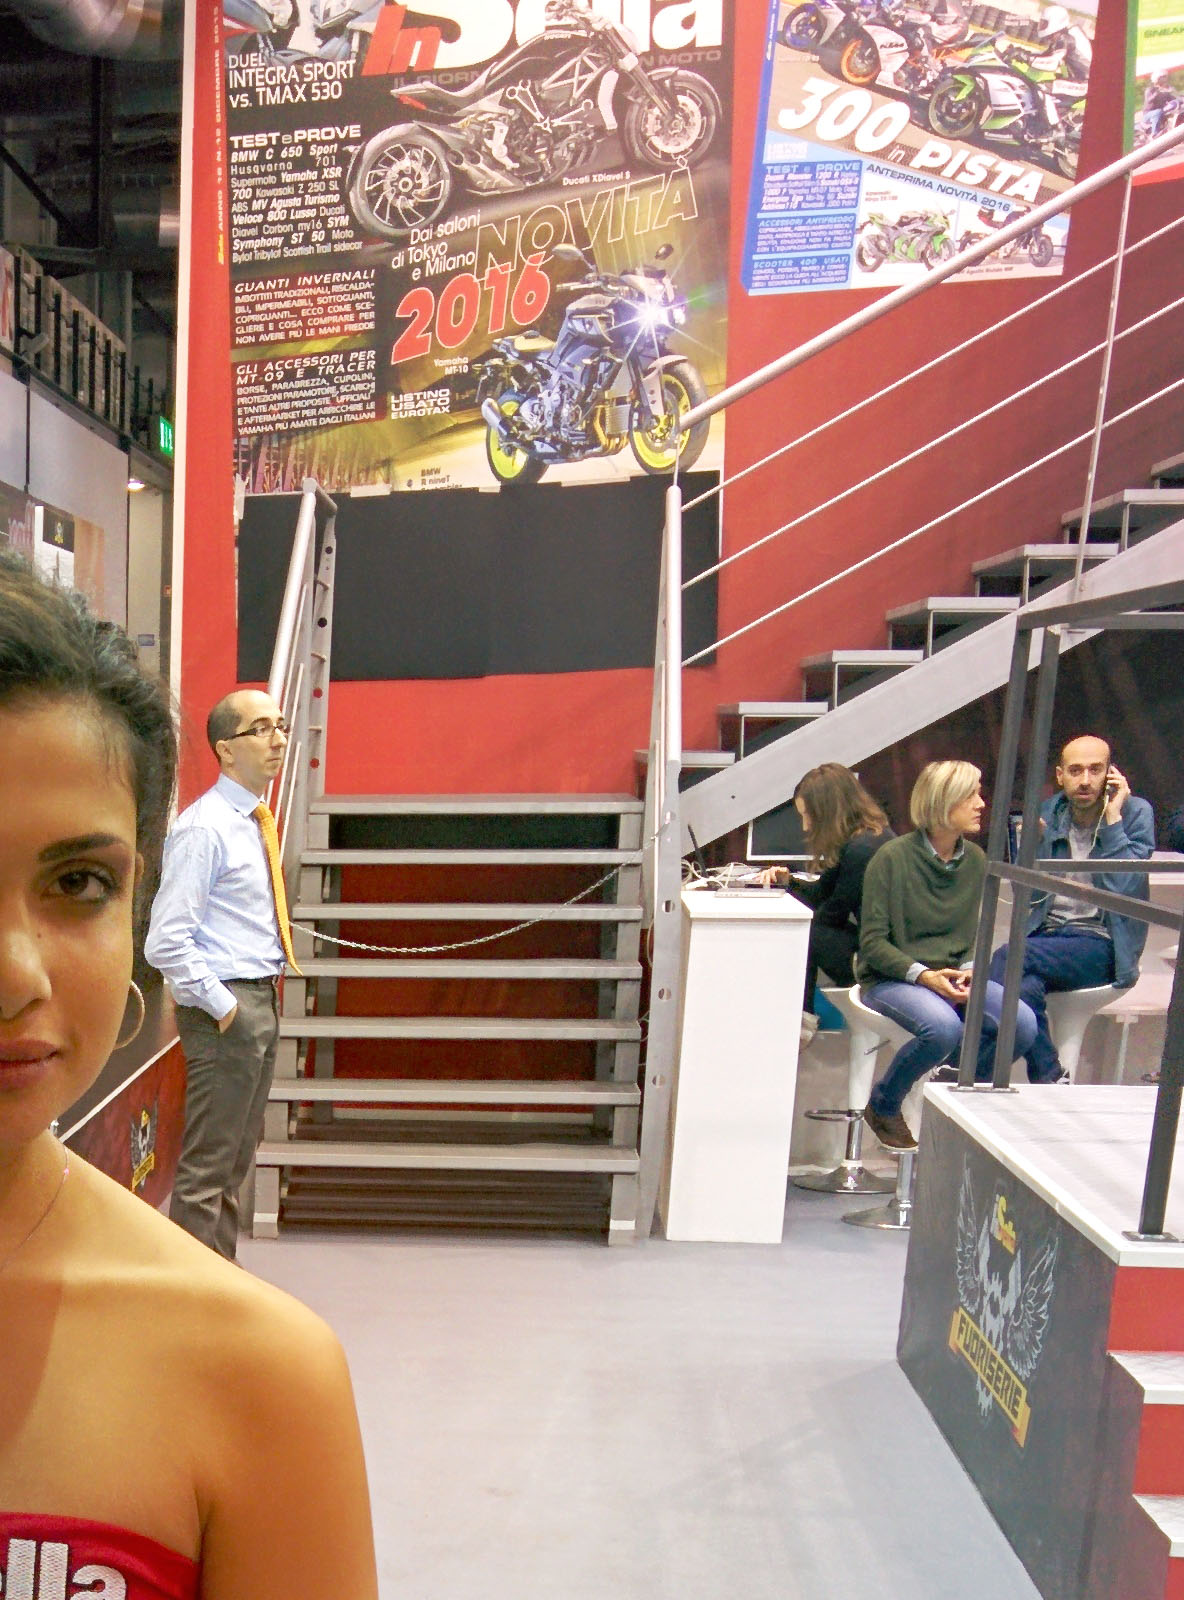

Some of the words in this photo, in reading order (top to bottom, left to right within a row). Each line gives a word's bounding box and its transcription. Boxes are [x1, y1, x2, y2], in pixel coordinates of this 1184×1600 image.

[229, 52, 266, 68] DUEL
[229, 66, 299, 89] INTEGRA
[303, 59, 356, 81] SPORT
[256, 83, 307, 105] TMAX
[311, 80, 342, 100] 530
[230, 132, 280, 148] TEST
[294, 125, 361, 143] PROVE
[778, 77, 911, 153] 300
[888, 146, 903, 164] in
[910, 139, 1044, 203] PISTA
[231, 150, 259, 163] BMW
[265, 148, 274, 159] C
[281, 145, 303, 158] 650
[309, 143, 338, 156] Sport
[231, 162, 292, 175] Husqvarna
[316, 155, 336, 166] 701
[281, 170, 317, 183] Yamaha
[322, 167, 342, 179] XSR
[765, 164, 799, 174] TEST
[816, 162, 861, 172] PROVE
[232, 189, 252, 200] 700
[256, 185, 294, 198] Kawasaki
[308, 181, 325, 192] 250
[329, 181, 340, 190] SL
[562, 175, 590, 186] Ducati
[867, 163, 934, 190] ANTEPRIMA
[937, 183, 979, 203] NOVITÀ
[980, 196, 1012, 212] 2016
[232, 202, 248, 213] ABS
[252, 200, 268, 211] MV
[270, 195, 302, 209] Agusta
[304, 193, 340, 205] Turismo
[232, 213, 264, 226] Veloce
[267, 210, 287, 222] 800
[290, 208, 316, 219] Lusso
[320, 205, 345, 216] Ducati
[262, 223, 293, 235] Carbon
[327, 215, 349, 228] SYM
[474, 155, 698, 282] NOVITÀ
[410, 224, 434, 244] Dai
[436, 210, 480, 237] saloni
[233, 236, 284, 251] Symphony
[291, 232, 304, 244] ST
[311, 230, 325, 241] 50
[332, 229, 354, 240] Moto
[392, 251, 405, 270] di
[407, 242, 448, 267] Tokyo
[412, 267, 420, 281] e
[425, 251, 476, 278] Milano
[235, 278, 290, 293] GUANTI
[297, 269, 375, 285] INVERNALI
[301, 306, 324, 317] ECCO
[327, 304, 352, 313] COME
[355, 302, 375, 311] SCE-
[391, 251, 550, 365] 2016
[235, 324, 264, 335] GLIERE
[278, 318, 302, 329] COSA
[307, 314, 355, 326] COMPRARE
[359, 311, 375, 320] PER
[235, 335, 255, 344] NON
[258, 331, 285, 342] AVERE
[306, 328, 315, 337] LE
[319, 325, 341, 335] MANI
[236, 364, 258, 375] GLI
[264, 354, 343, 372] ACCESSORI
[349, 350, 376, 362] PER
[296, 368, 305, 378] E
[318, 360, 376, 375] TRACER
[434, 356, 468, 367] Yamaha
[391, 388, 450, 402] LISTINO
[391, 397, 450, 411] USATO
[391, 406, 450, 420] EUROTAX
[957, 1313, 1022, 1419] FUORISERIE
